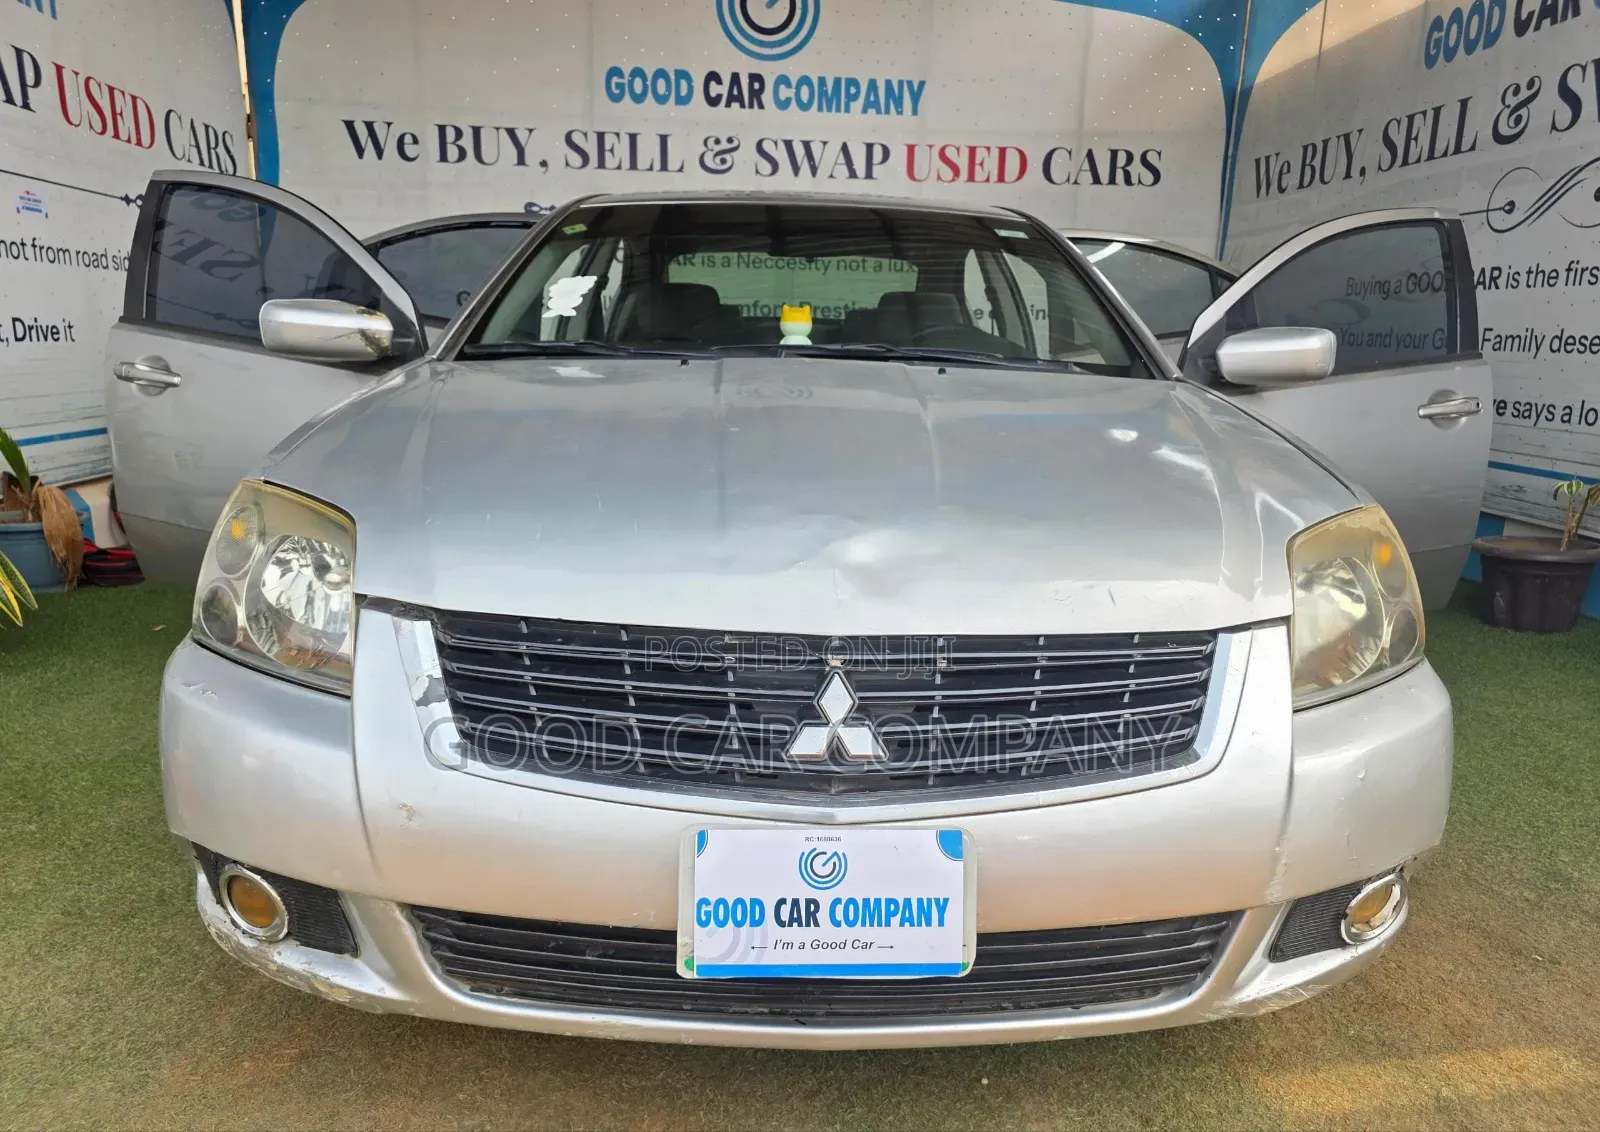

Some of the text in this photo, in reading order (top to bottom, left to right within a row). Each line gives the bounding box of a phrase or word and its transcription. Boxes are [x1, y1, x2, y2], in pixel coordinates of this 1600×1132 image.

[1424, 0, 1506, 70] GOOD
[605, 66, 926, 116] GOOD CAR COMPANY
[51, 61, 156, 150] USED
[164, 109, 237, 176] CARS
[1254, 58, 1600, 199] We BUY, SELL & S
[341, 119, 1163, 188] We BUY, SELL & SWAP USED CARS
[31, 237, 73, 266] from
[76, 248, 110, 270] road
[721, 255, 732, 269] a
[836, 257, 868, 273] not
[872, 260, 883, 273] a
[1345, 275, 1392, 301] Buying
[1393, 278, 1403, 295] a
[1406, 270, 1446, 295] GOO
[1505, 265, 1521, 290] is
[1526, 263, 1560, 289] the
[11, 316, 61, 343] Drive
[63, 317, 76, 343] it
[1340, 327, 1365, 348] You
[1366, 327, 1394, 348] and
[1395, 332, 1430, 353] your
[1480, 327, 1546, 359] Family
[1511, 400, 1556, 427] says
[1560, 404, 1573, 424] a
[696, 897, 950, 928] GOOD CAR COMPANY
[773, 939, 875, 950] I'm a Good Car
